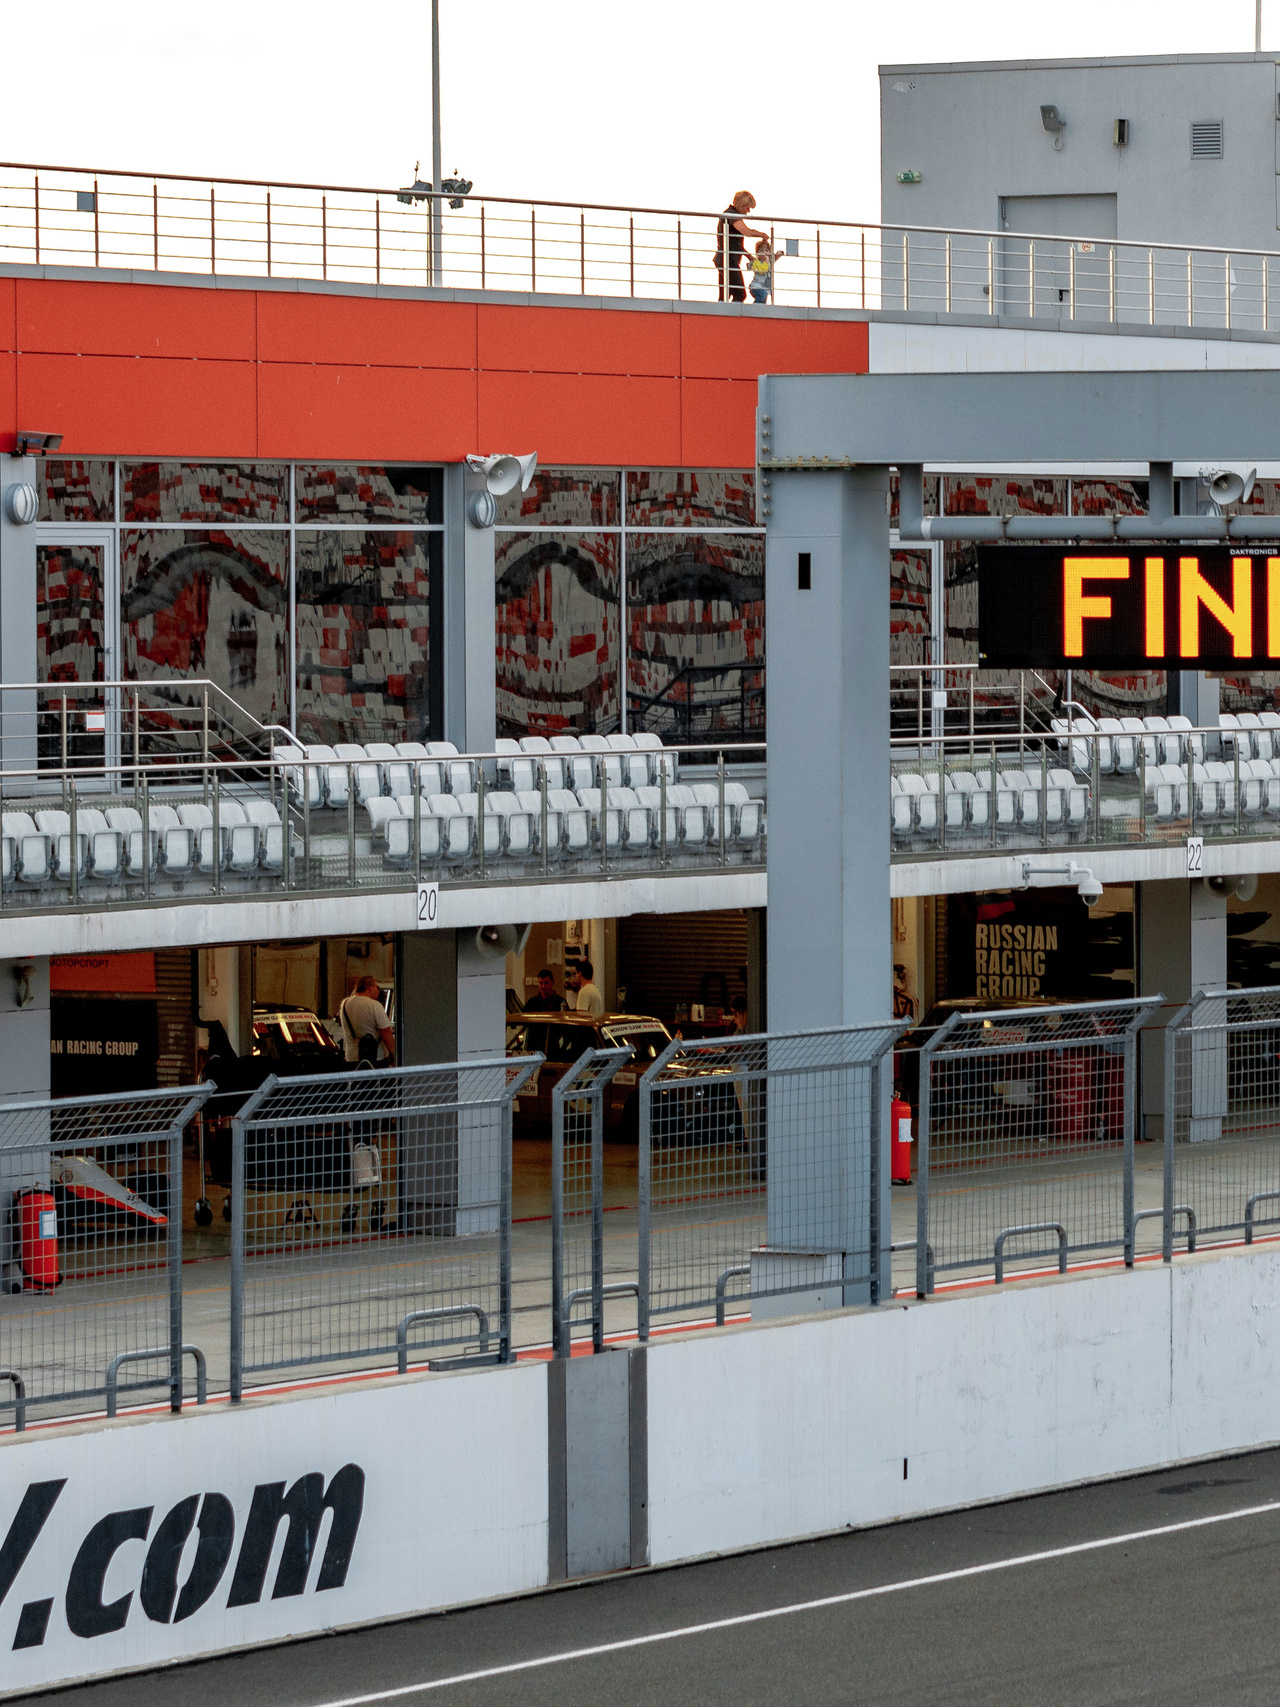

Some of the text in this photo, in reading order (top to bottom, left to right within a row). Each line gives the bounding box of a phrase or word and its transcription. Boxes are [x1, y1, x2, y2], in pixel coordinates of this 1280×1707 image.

[1188, 843, 1202, 871] 22
[418, 888, 437, 921] 20
[975, 923, 1058, 951] RUSSIAN
[975, 949, 1046, 976] RACING
[976, 974, 1041, 999] GROUP
[66, 1040, 103, 1055] RACING
[105, 1041, 139, 1056] GROUP
